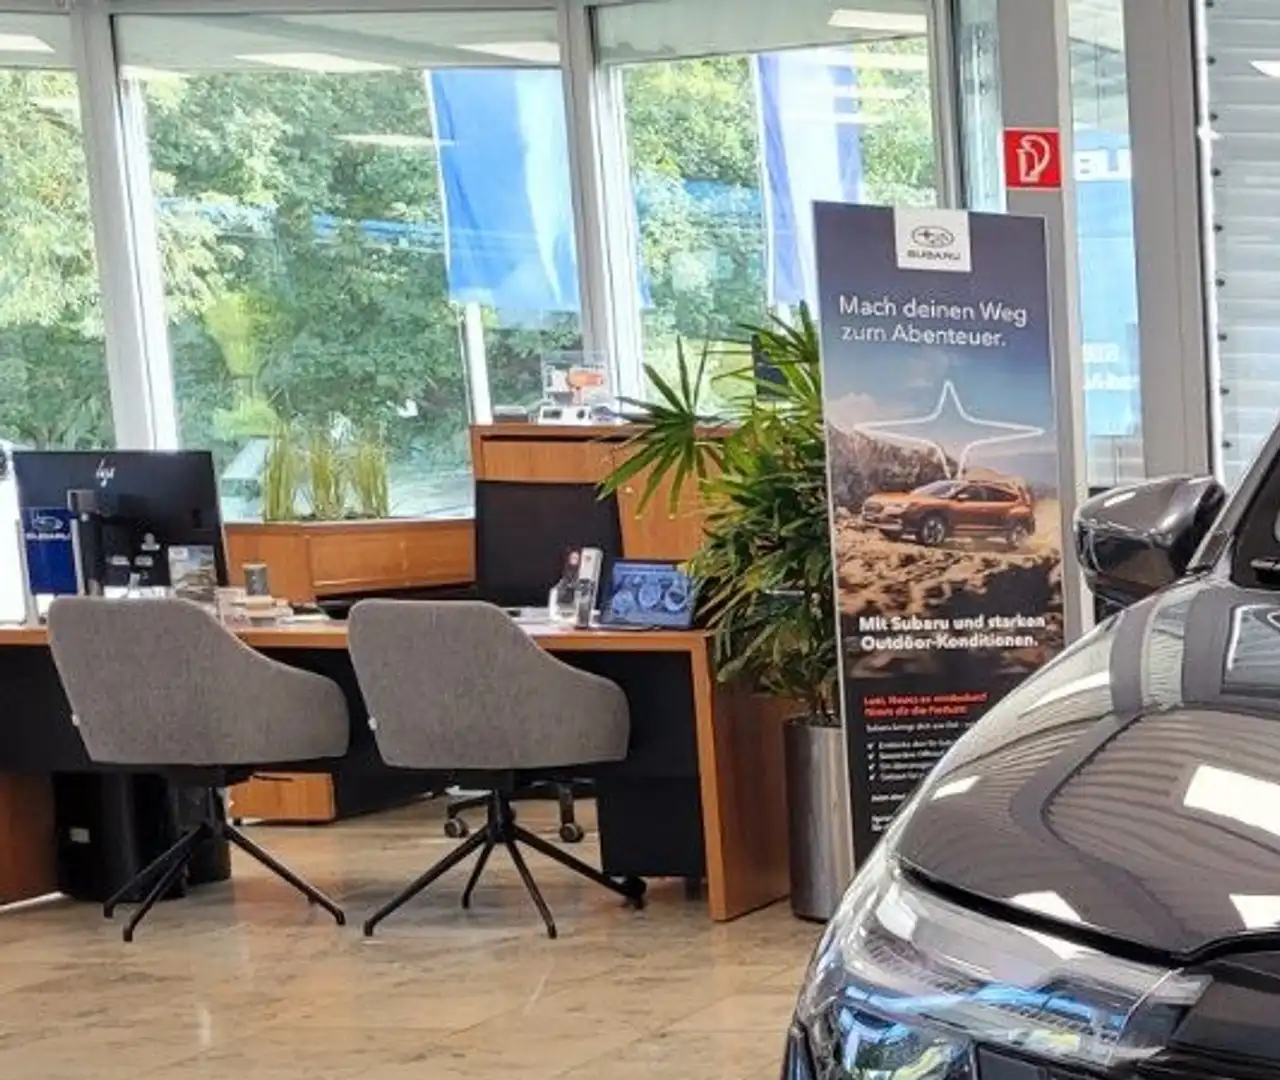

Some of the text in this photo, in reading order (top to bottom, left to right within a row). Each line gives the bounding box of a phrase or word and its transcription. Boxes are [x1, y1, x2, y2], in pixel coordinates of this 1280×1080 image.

[839, 295, 1027, 328] Mach deinen Weg
[841, 324, 1007, 347] zum Abenteuer.
[859, 612, 1046, 632] Mit Subaru und starken
